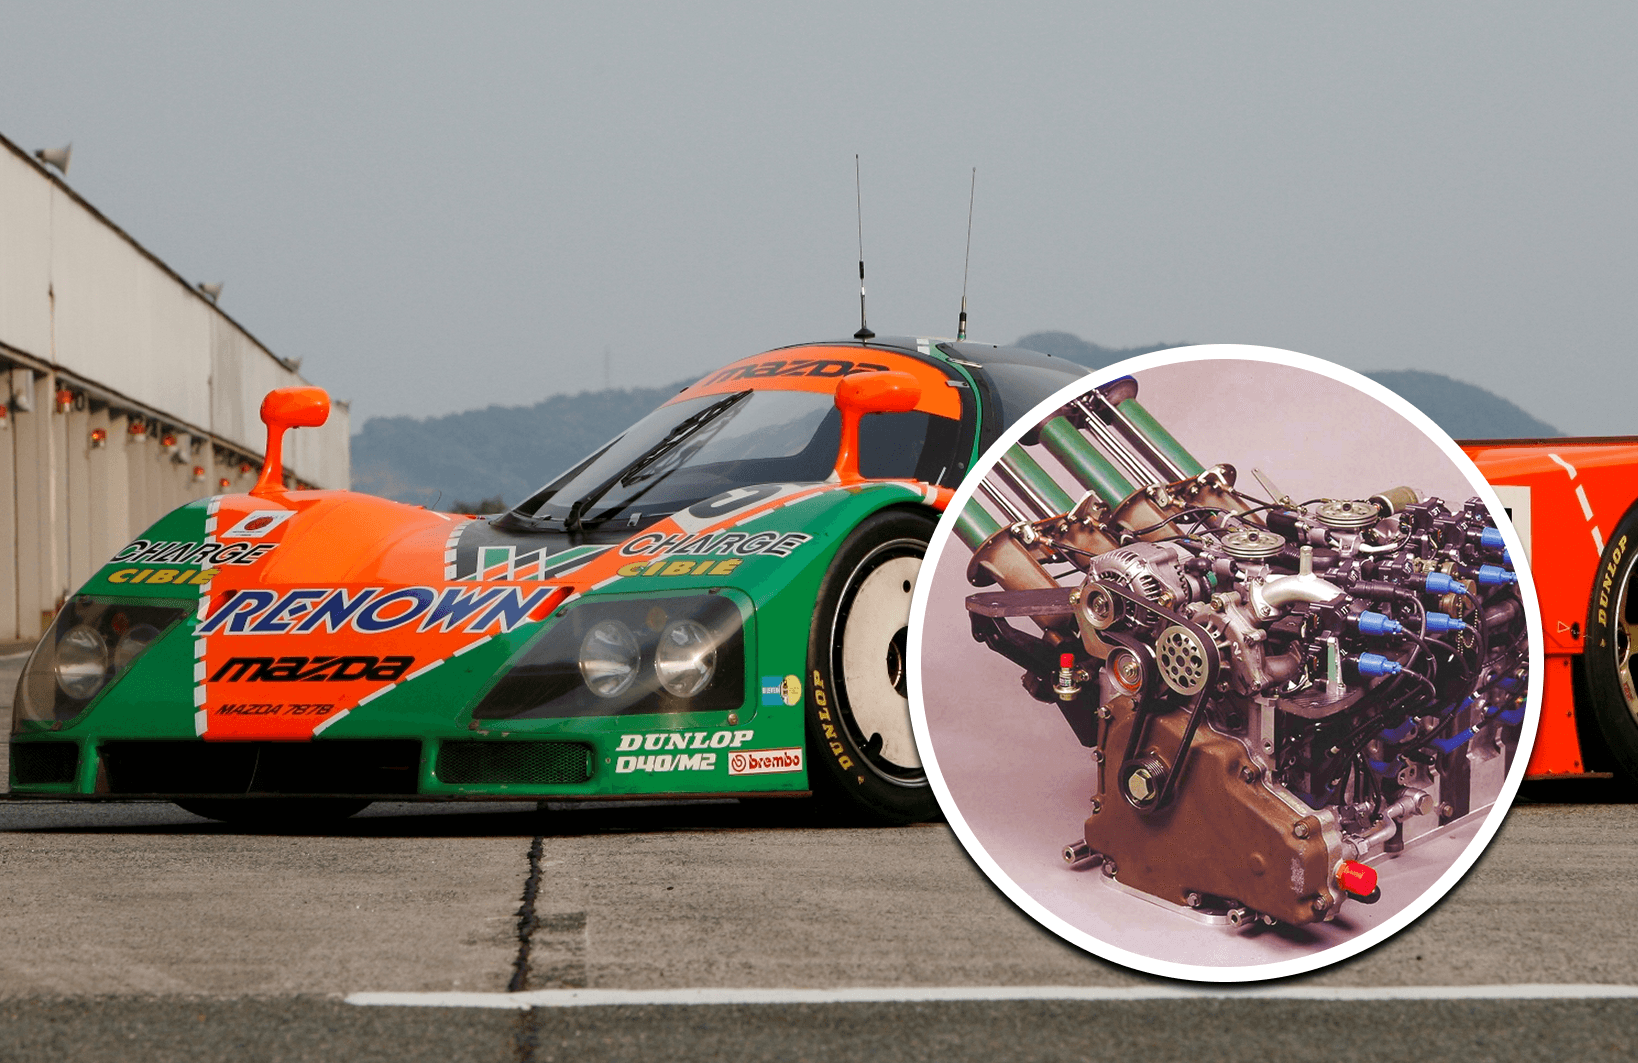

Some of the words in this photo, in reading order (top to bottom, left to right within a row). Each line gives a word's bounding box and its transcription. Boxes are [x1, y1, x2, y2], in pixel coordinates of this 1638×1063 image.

[110, 540, 280, 566] CHARGE
[619, 531, 813, 558] CHARGE
[1598, 534, 1628, 628] DUNLOP
[193, 586, 558, 635] RENOWN
[214, 703, 284, 715] MAZDA
[813, 669, 854, 771] DUNLOP
[615, 730, 754, 751] DUNLOP
[615, 753, 717, 773] D40/M2
[749, 752, 800, 770] brembo
